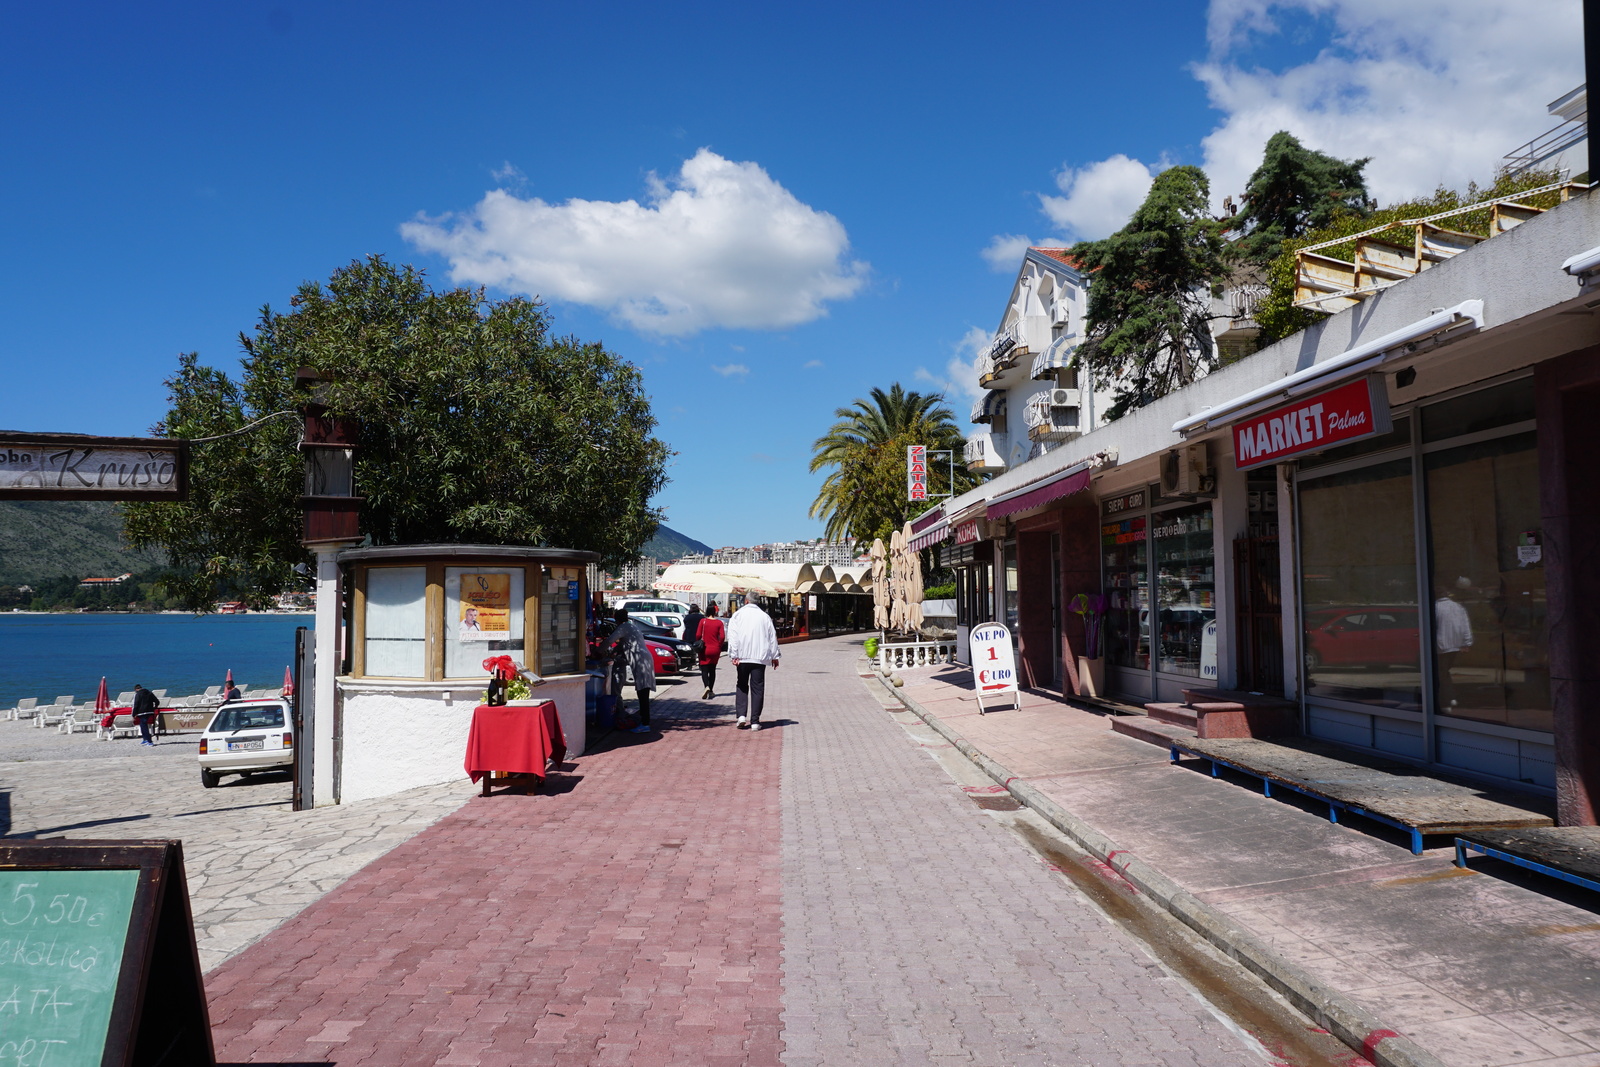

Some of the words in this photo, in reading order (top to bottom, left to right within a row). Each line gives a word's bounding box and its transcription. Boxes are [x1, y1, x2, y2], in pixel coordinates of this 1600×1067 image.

[1239, 402, 1324, 462] MARKET
[1328, 409, 1366, 434] Palma
[50, 448, 176, 488] Krušo
[911, 446, 925, 499] ZLATAR
[975, 631, 991, 642] SVE
[993, 630, 1005, 640] PO
[987, 647, 998, 661] 1
